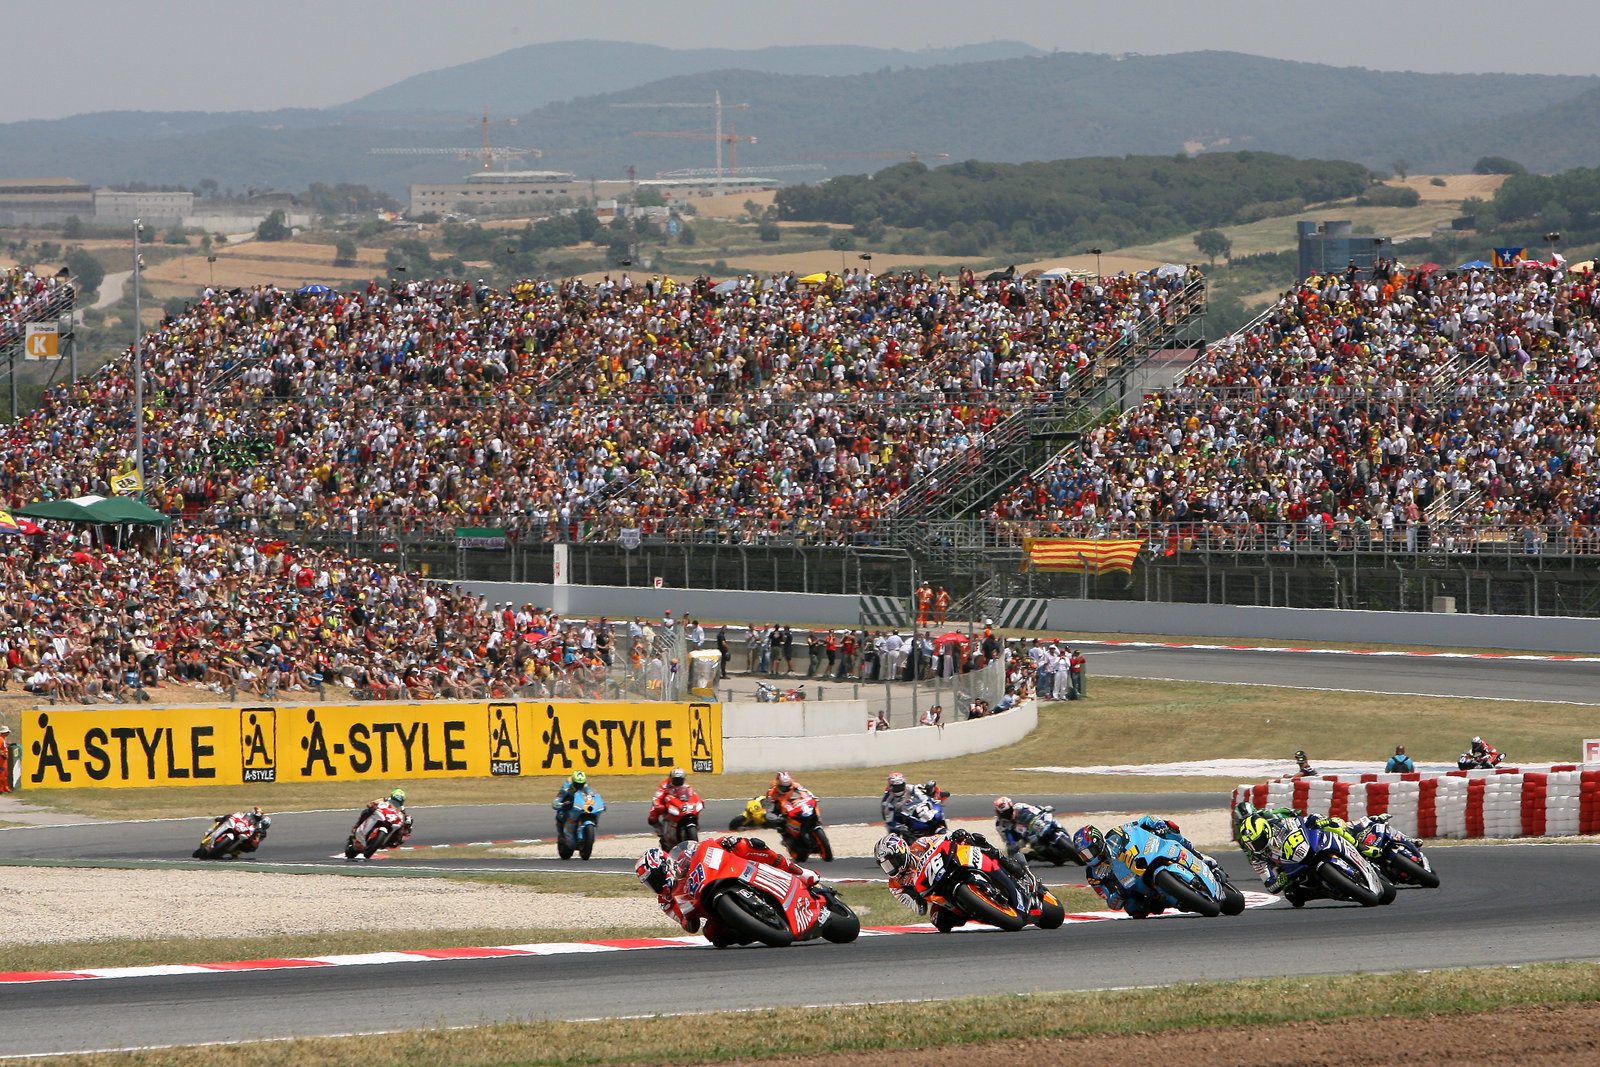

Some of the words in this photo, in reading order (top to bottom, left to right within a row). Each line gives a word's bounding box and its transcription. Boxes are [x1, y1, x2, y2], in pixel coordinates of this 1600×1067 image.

[33, 336, 48, 354] K
[31, 724, 216, 783] A-STYLE
[300, 721, 467, 777] A-STYLE
[542, 717, 674, 769] A-STYLE
[1587, 743, 1600, 760] F
[244, 769, 274, 782] A-STYLE
[1283, 831, 1305, 860] 46
[684, 863, 706, 899] 27
[925, 852, 944, 886] 26
